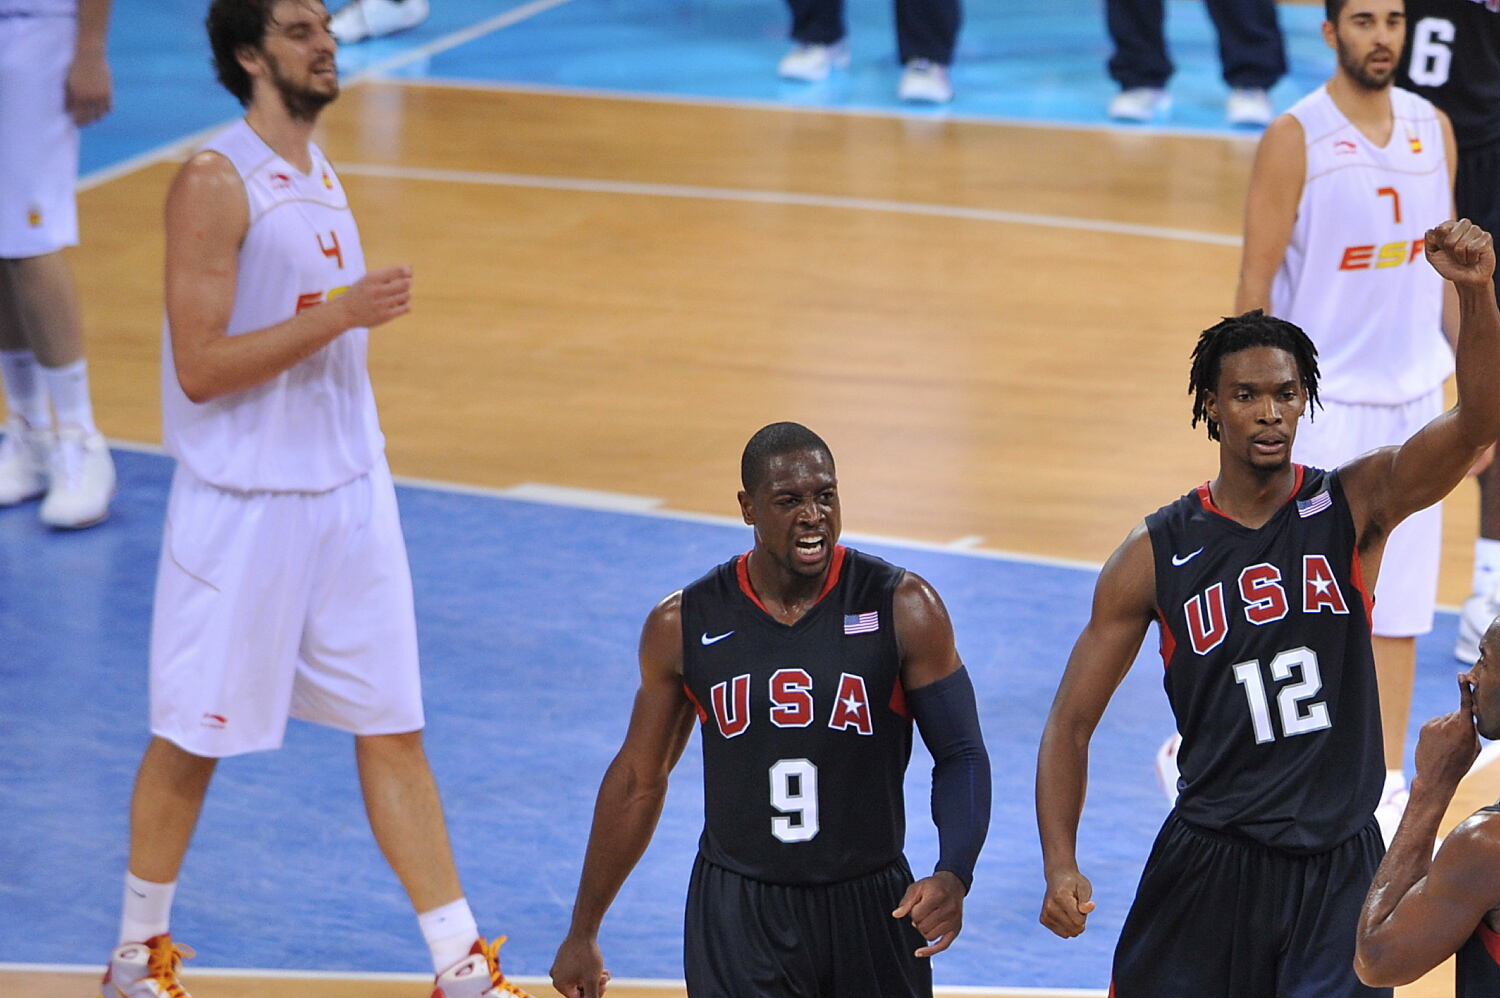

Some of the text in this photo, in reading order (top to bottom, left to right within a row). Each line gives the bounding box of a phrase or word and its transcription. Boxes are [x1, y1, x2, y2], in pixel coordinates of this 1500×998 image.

[1408, 16, 1456, 88] 6
[1376, 186, 1402, 224] 7
[315, 230, 344, 269] 4
[1183, 554, 1351, 656] USA
[710, 668, 874, 739] USA
[1232, 645, 1333, 745] 12
[768, 757, 820, 843] 9
